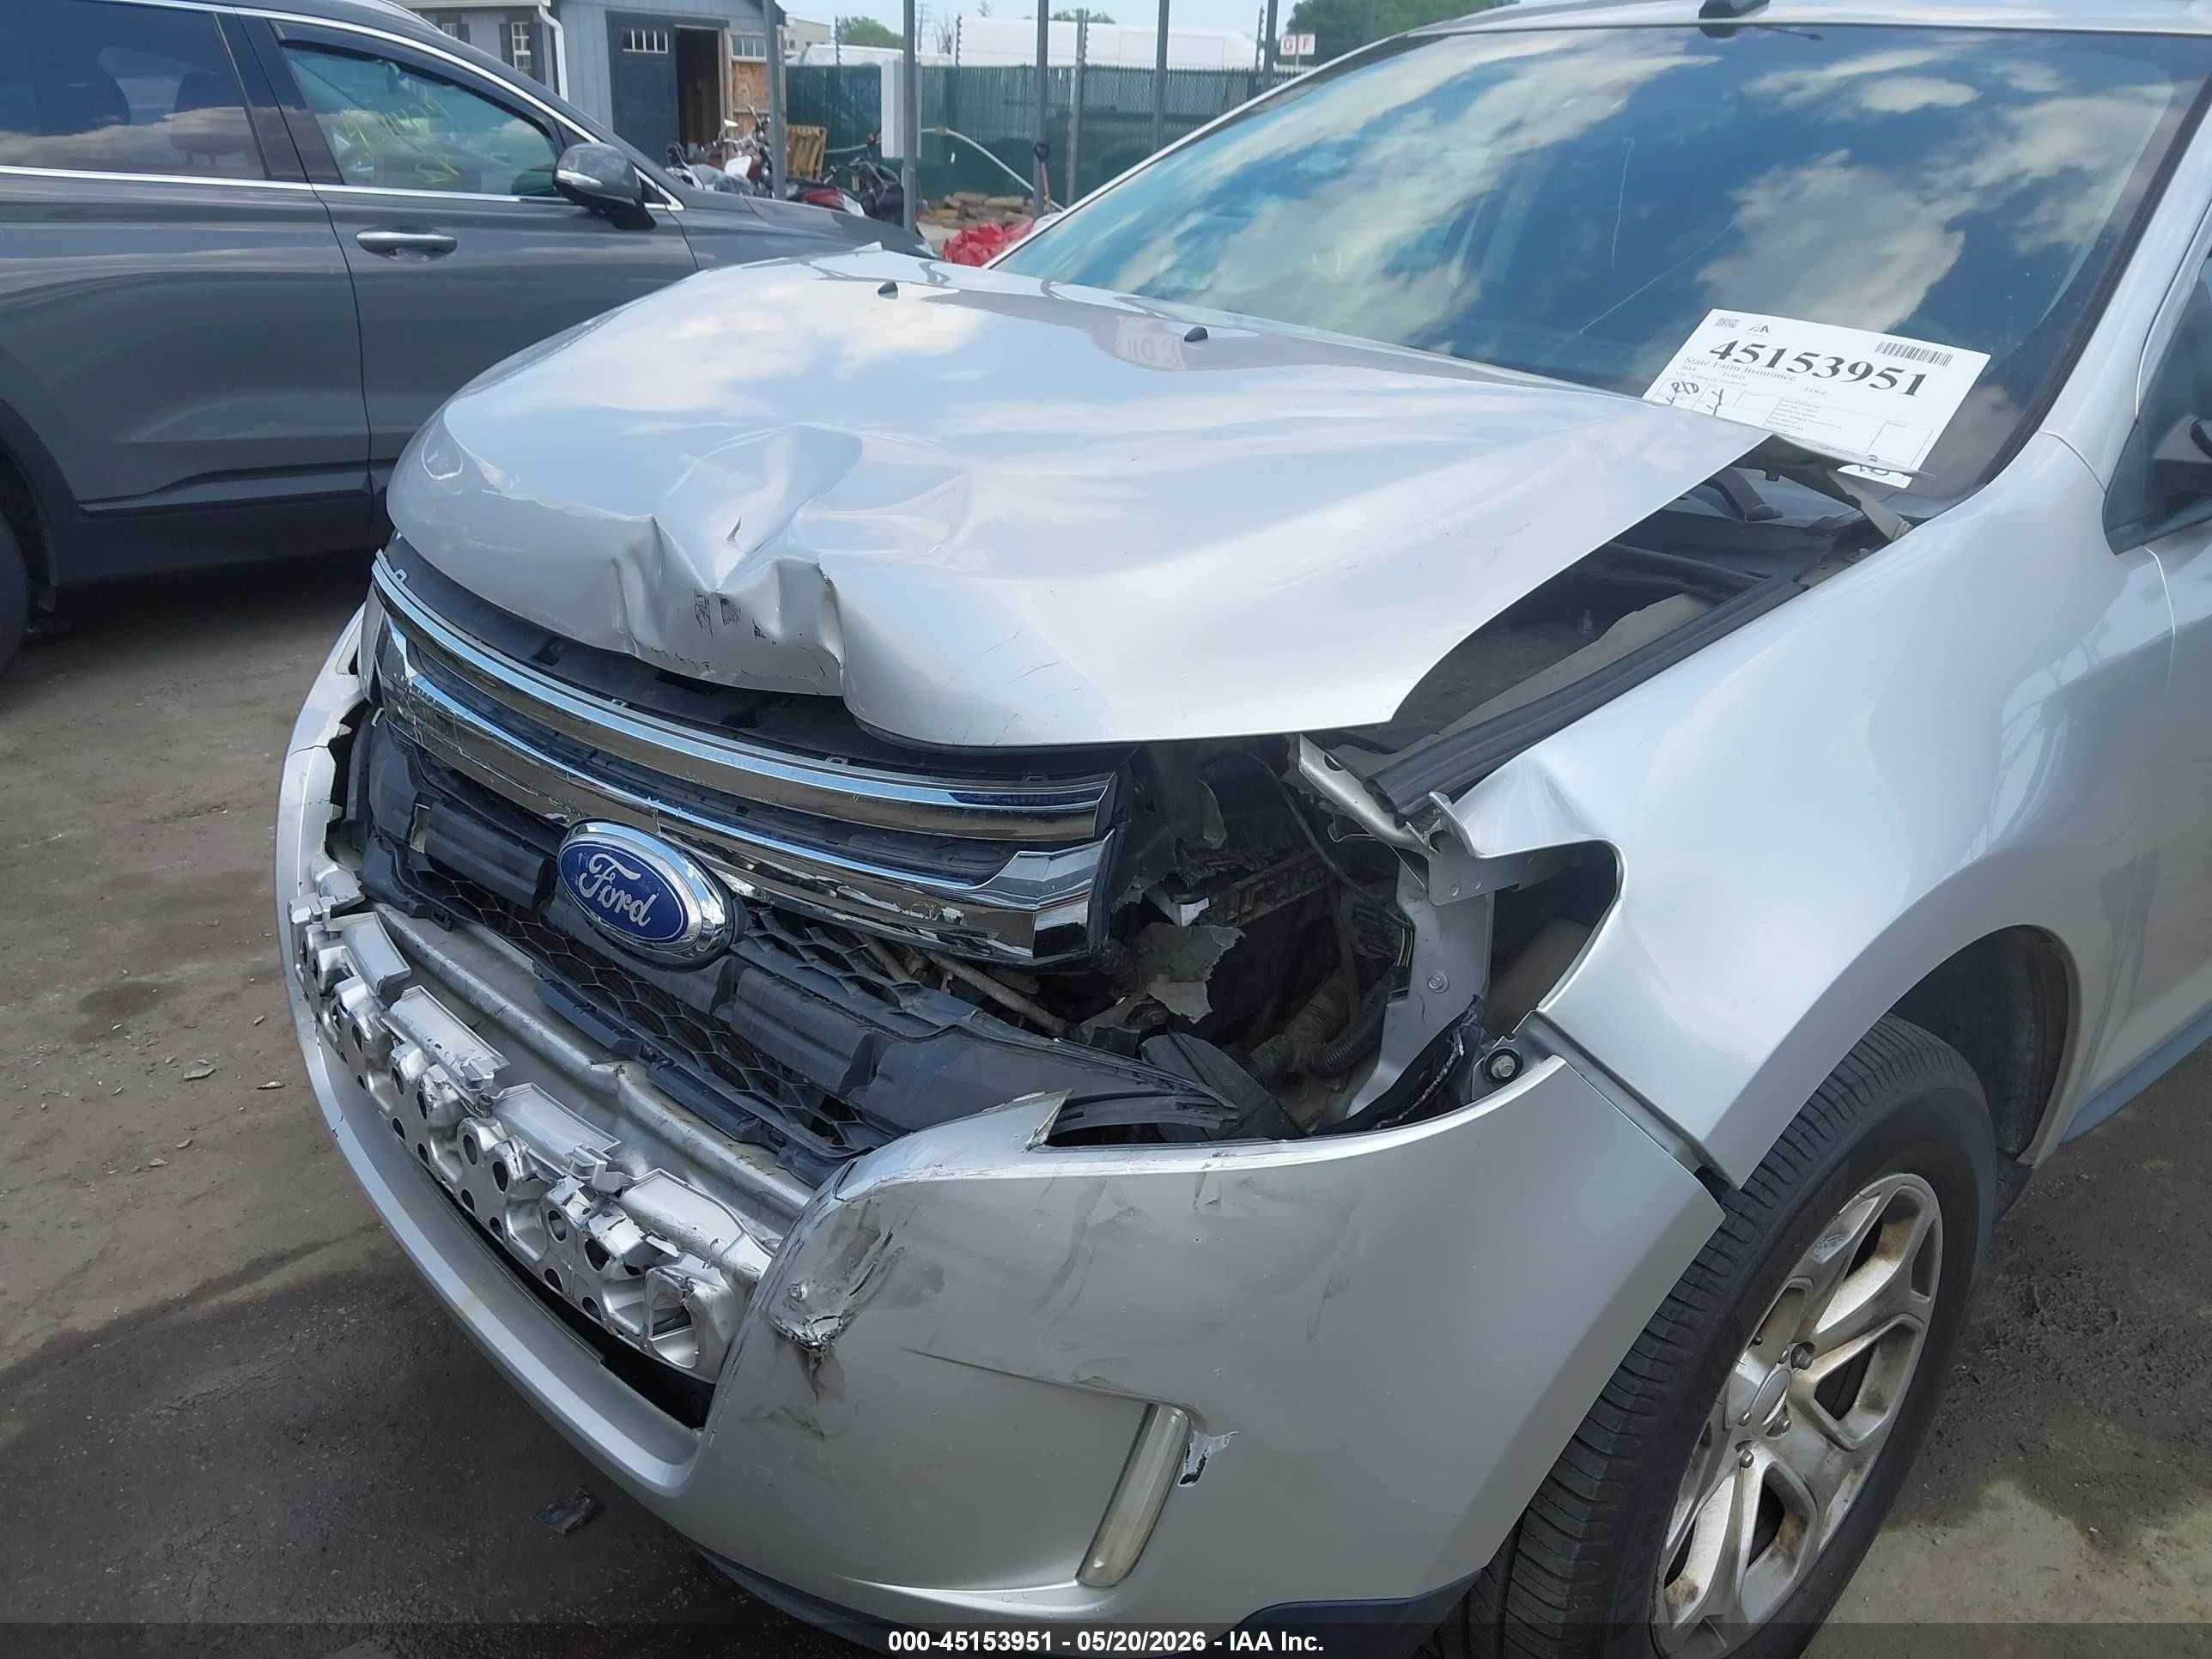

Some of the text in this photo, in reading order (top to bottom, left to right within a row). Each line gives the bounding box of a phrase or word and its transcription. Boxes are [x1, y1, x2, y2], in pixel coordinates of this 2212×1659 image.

[1284, 37, 1310, 50] G F
[1684, 356, 1710, 367] State
[1713, 361, 1741, 372] Farm
[1744, 365, 1797, 382] Insurance
[1709, 339, 1927, 398] 45153951
[577, 853, 659, 927] Ford
